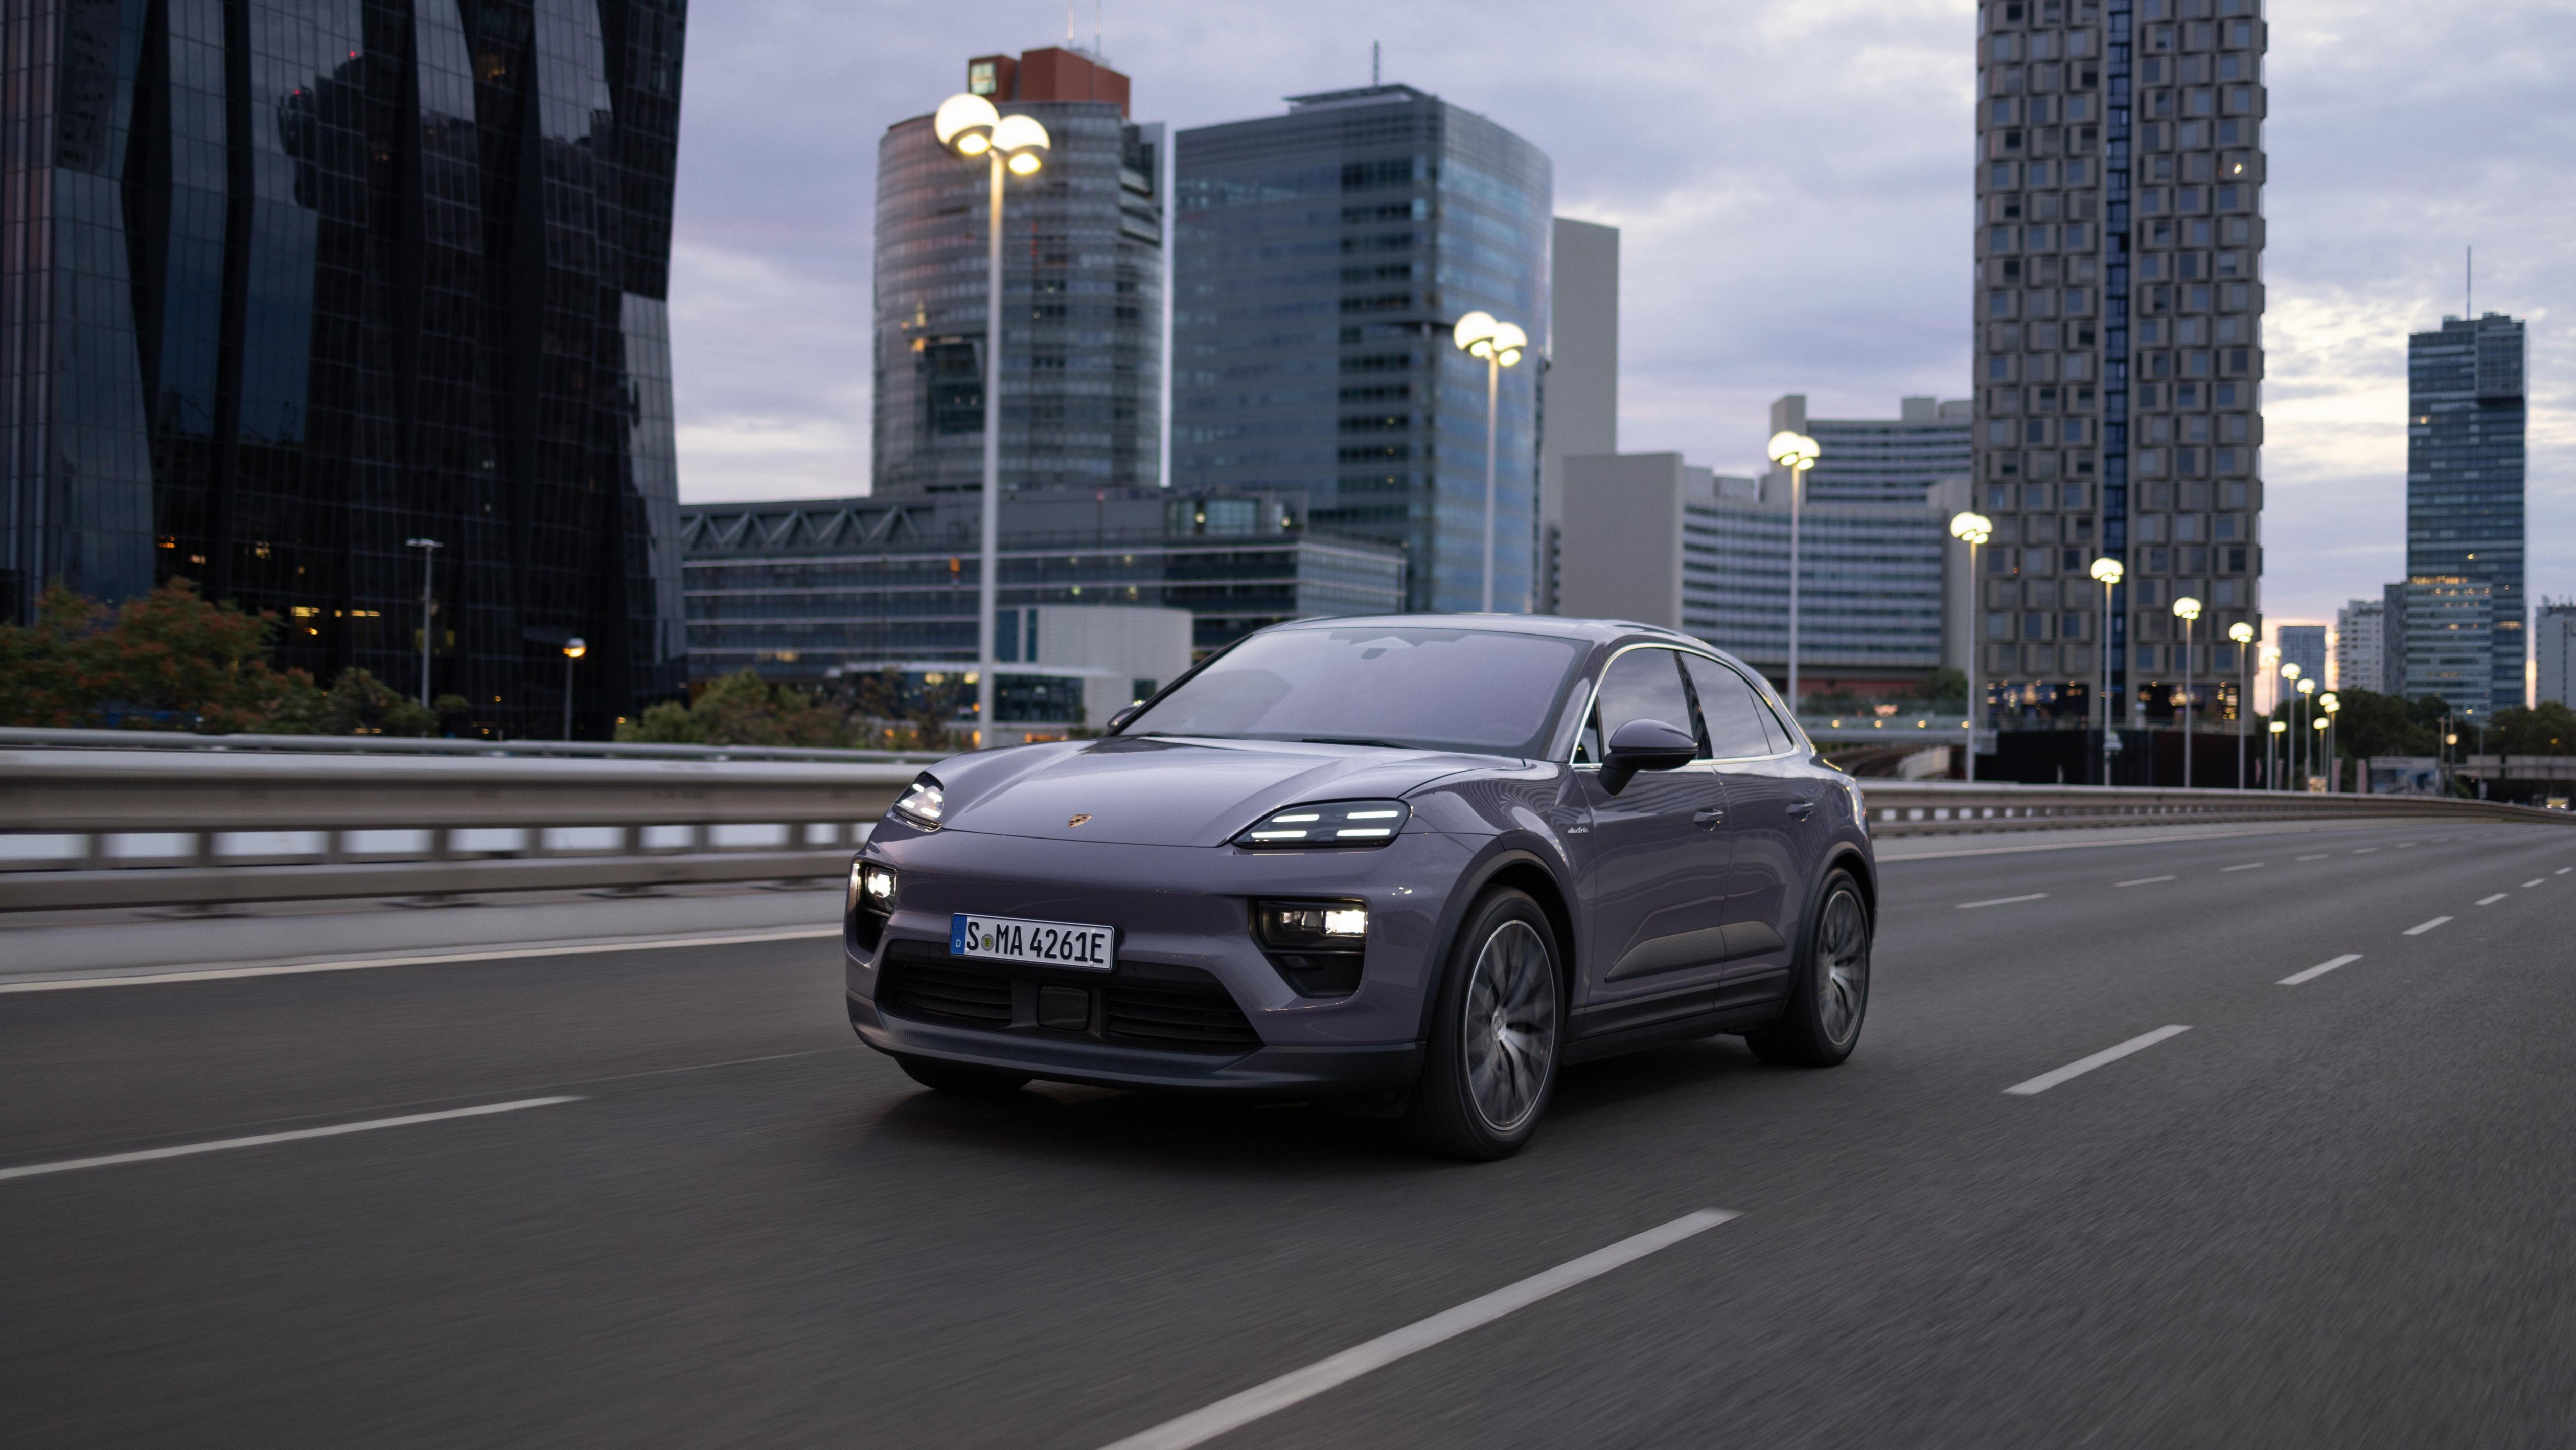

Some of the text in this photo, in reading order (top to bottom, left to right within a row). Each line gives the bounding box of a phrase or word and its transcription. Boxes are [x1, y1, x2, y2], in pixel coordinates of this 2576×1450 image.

[956, 939, 961, 947] D
[967, 922, 1105, 964] S MA 4261E
